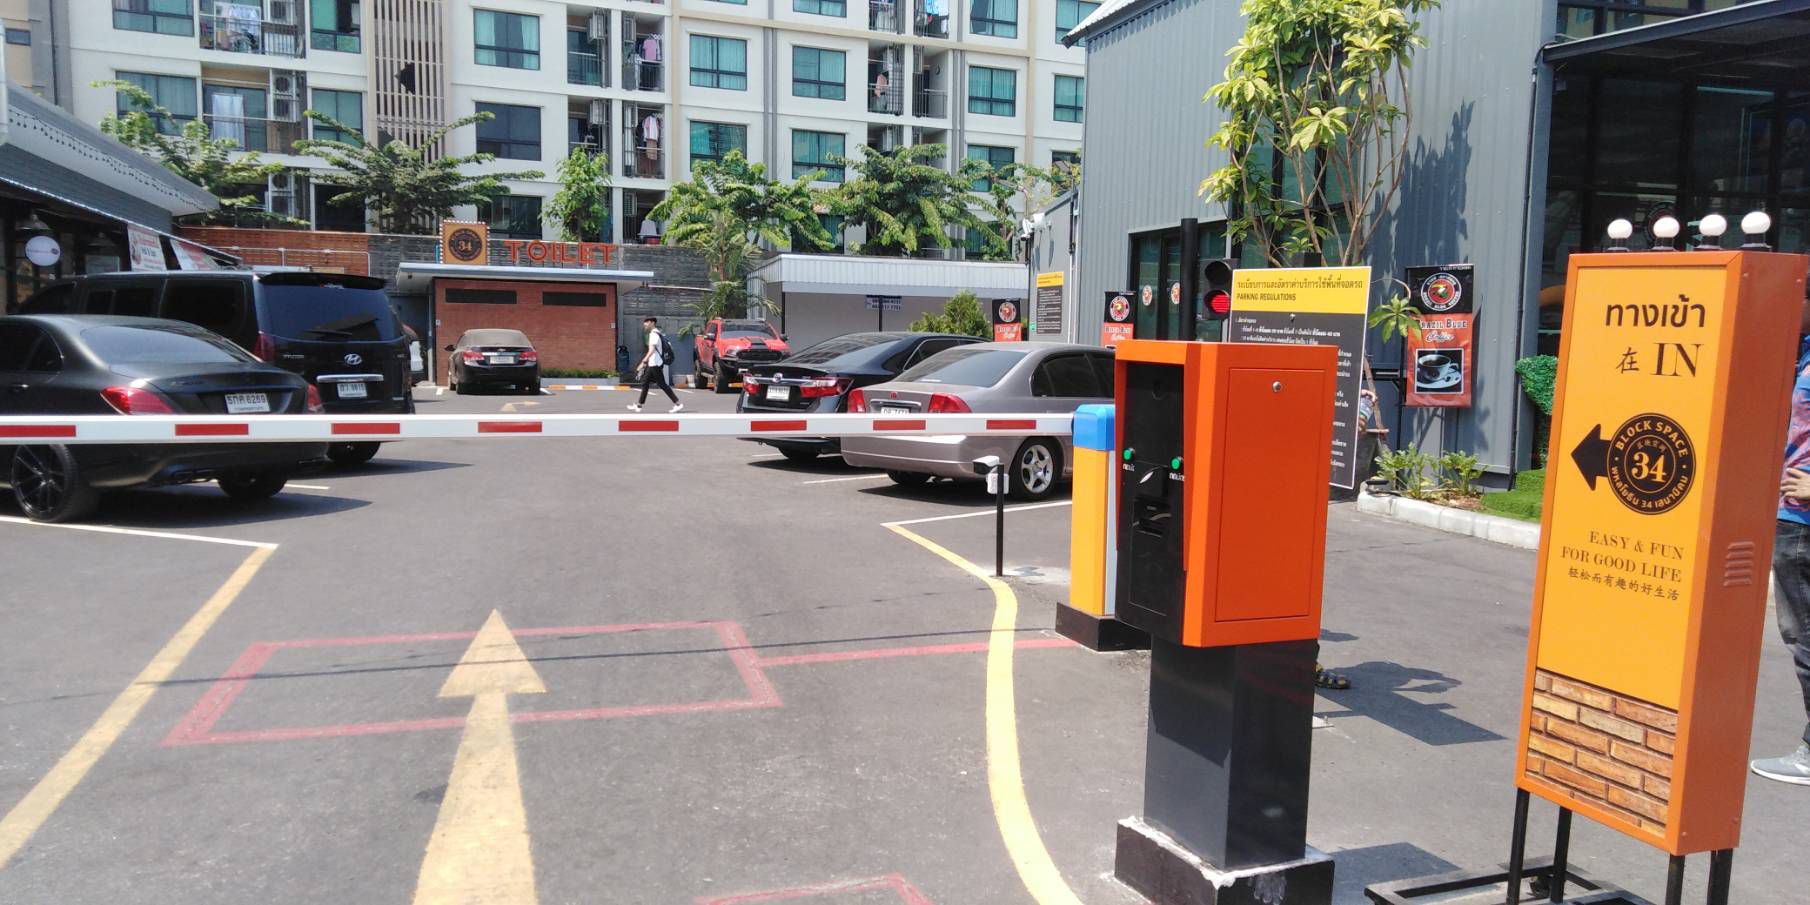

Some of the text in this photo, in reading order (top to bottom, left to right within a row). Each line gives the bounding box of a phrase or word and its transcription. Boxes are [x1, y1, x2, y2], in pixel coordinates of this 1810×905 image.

[458, 239, 473, 251] 34
[503, 240, 617, 264] TOILET
[1236, 293, 1297, 301] PARKING REGULATIONS
[1605, 294, 1706, 328] ทางเข้า
[1419, 318, 1444, 329] RAZIL
[1616, 346, 1640, 374] 在
[1649, 342, 1705, 377] IN
[1615, 420, 1689, 457] BLOCK SPACE
[1631, 451, 1667, 483] 34
[1641, 499, 1653, 508] 34
[1589, 530, 1684, 560] EASY & FUN
[1561, 546, 1682, 582] FOR GOOD LIFE
[1568, 566, 1680, 601] 轻松而有趣的好生活
